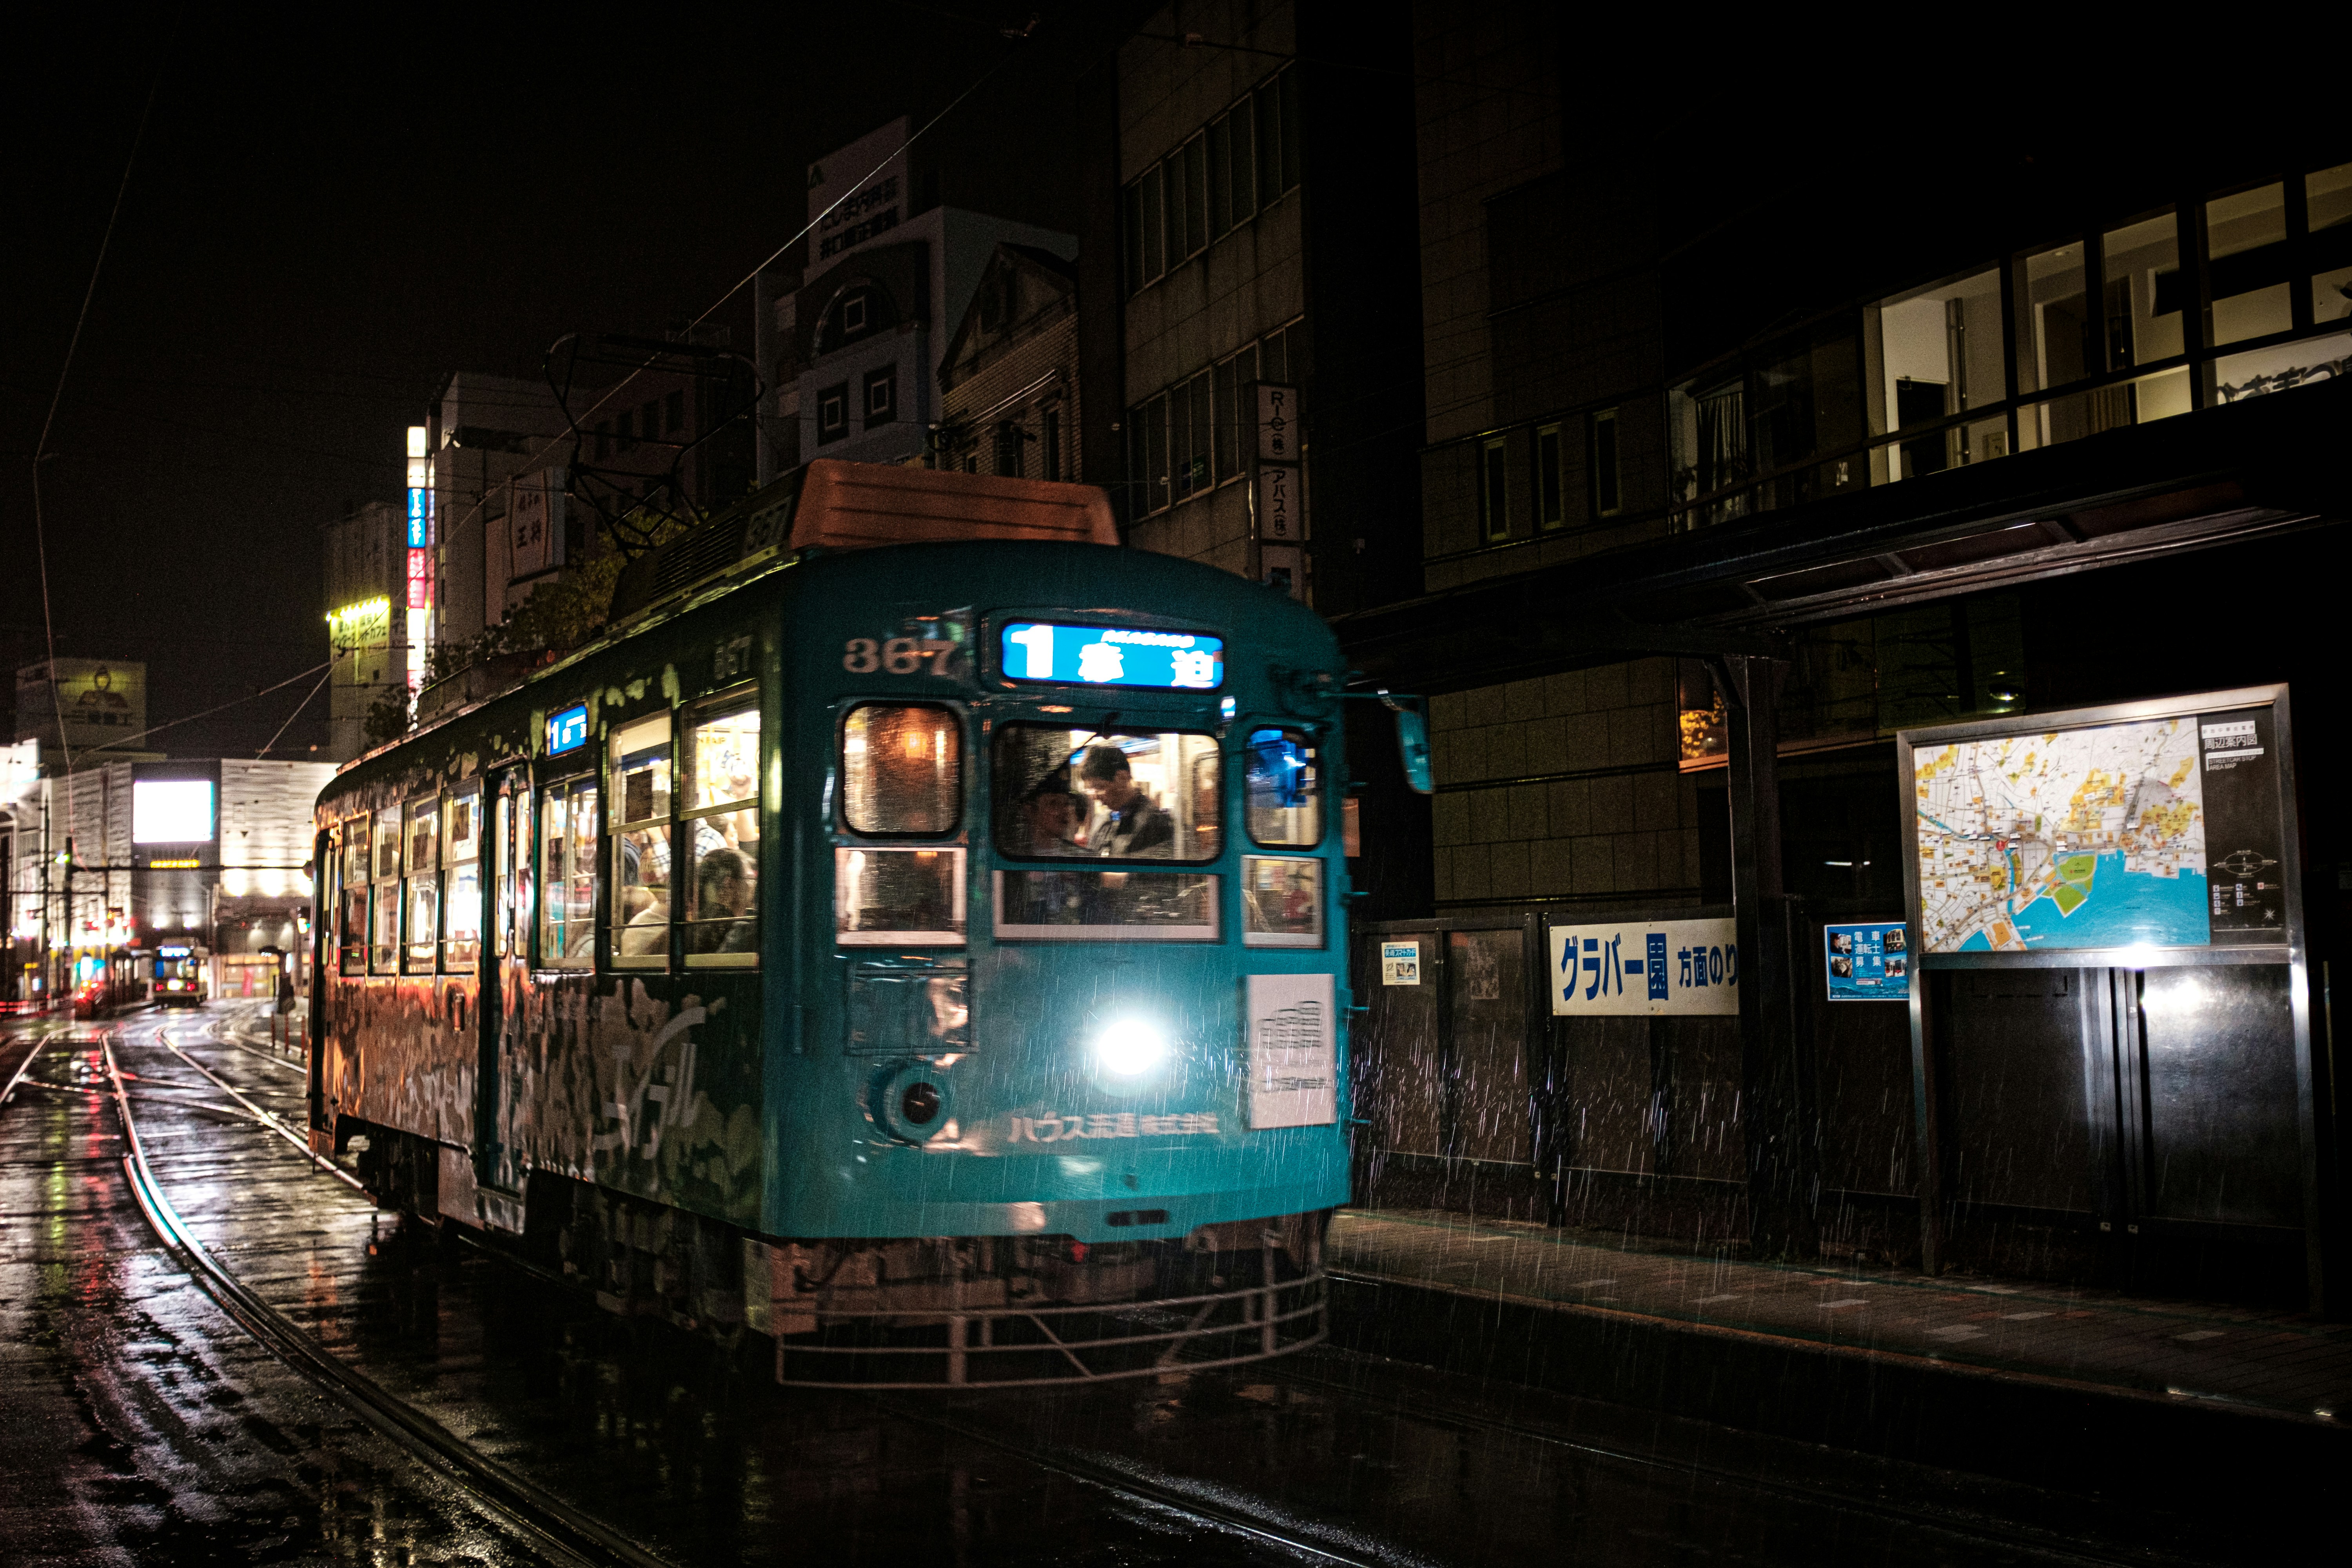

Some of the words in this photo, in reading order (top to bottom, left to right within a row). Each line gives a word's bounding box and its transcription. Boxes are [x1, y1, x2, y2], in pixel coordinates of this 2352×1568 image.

[843, 638, 957, 675] 367
[1011, 625, 1053, 678] 1
[551, 721, 559, 750] 1
[2204, 734, 2258, 750] 周辺案内図
[1561, 933, 1669, 1002] グラバー園
